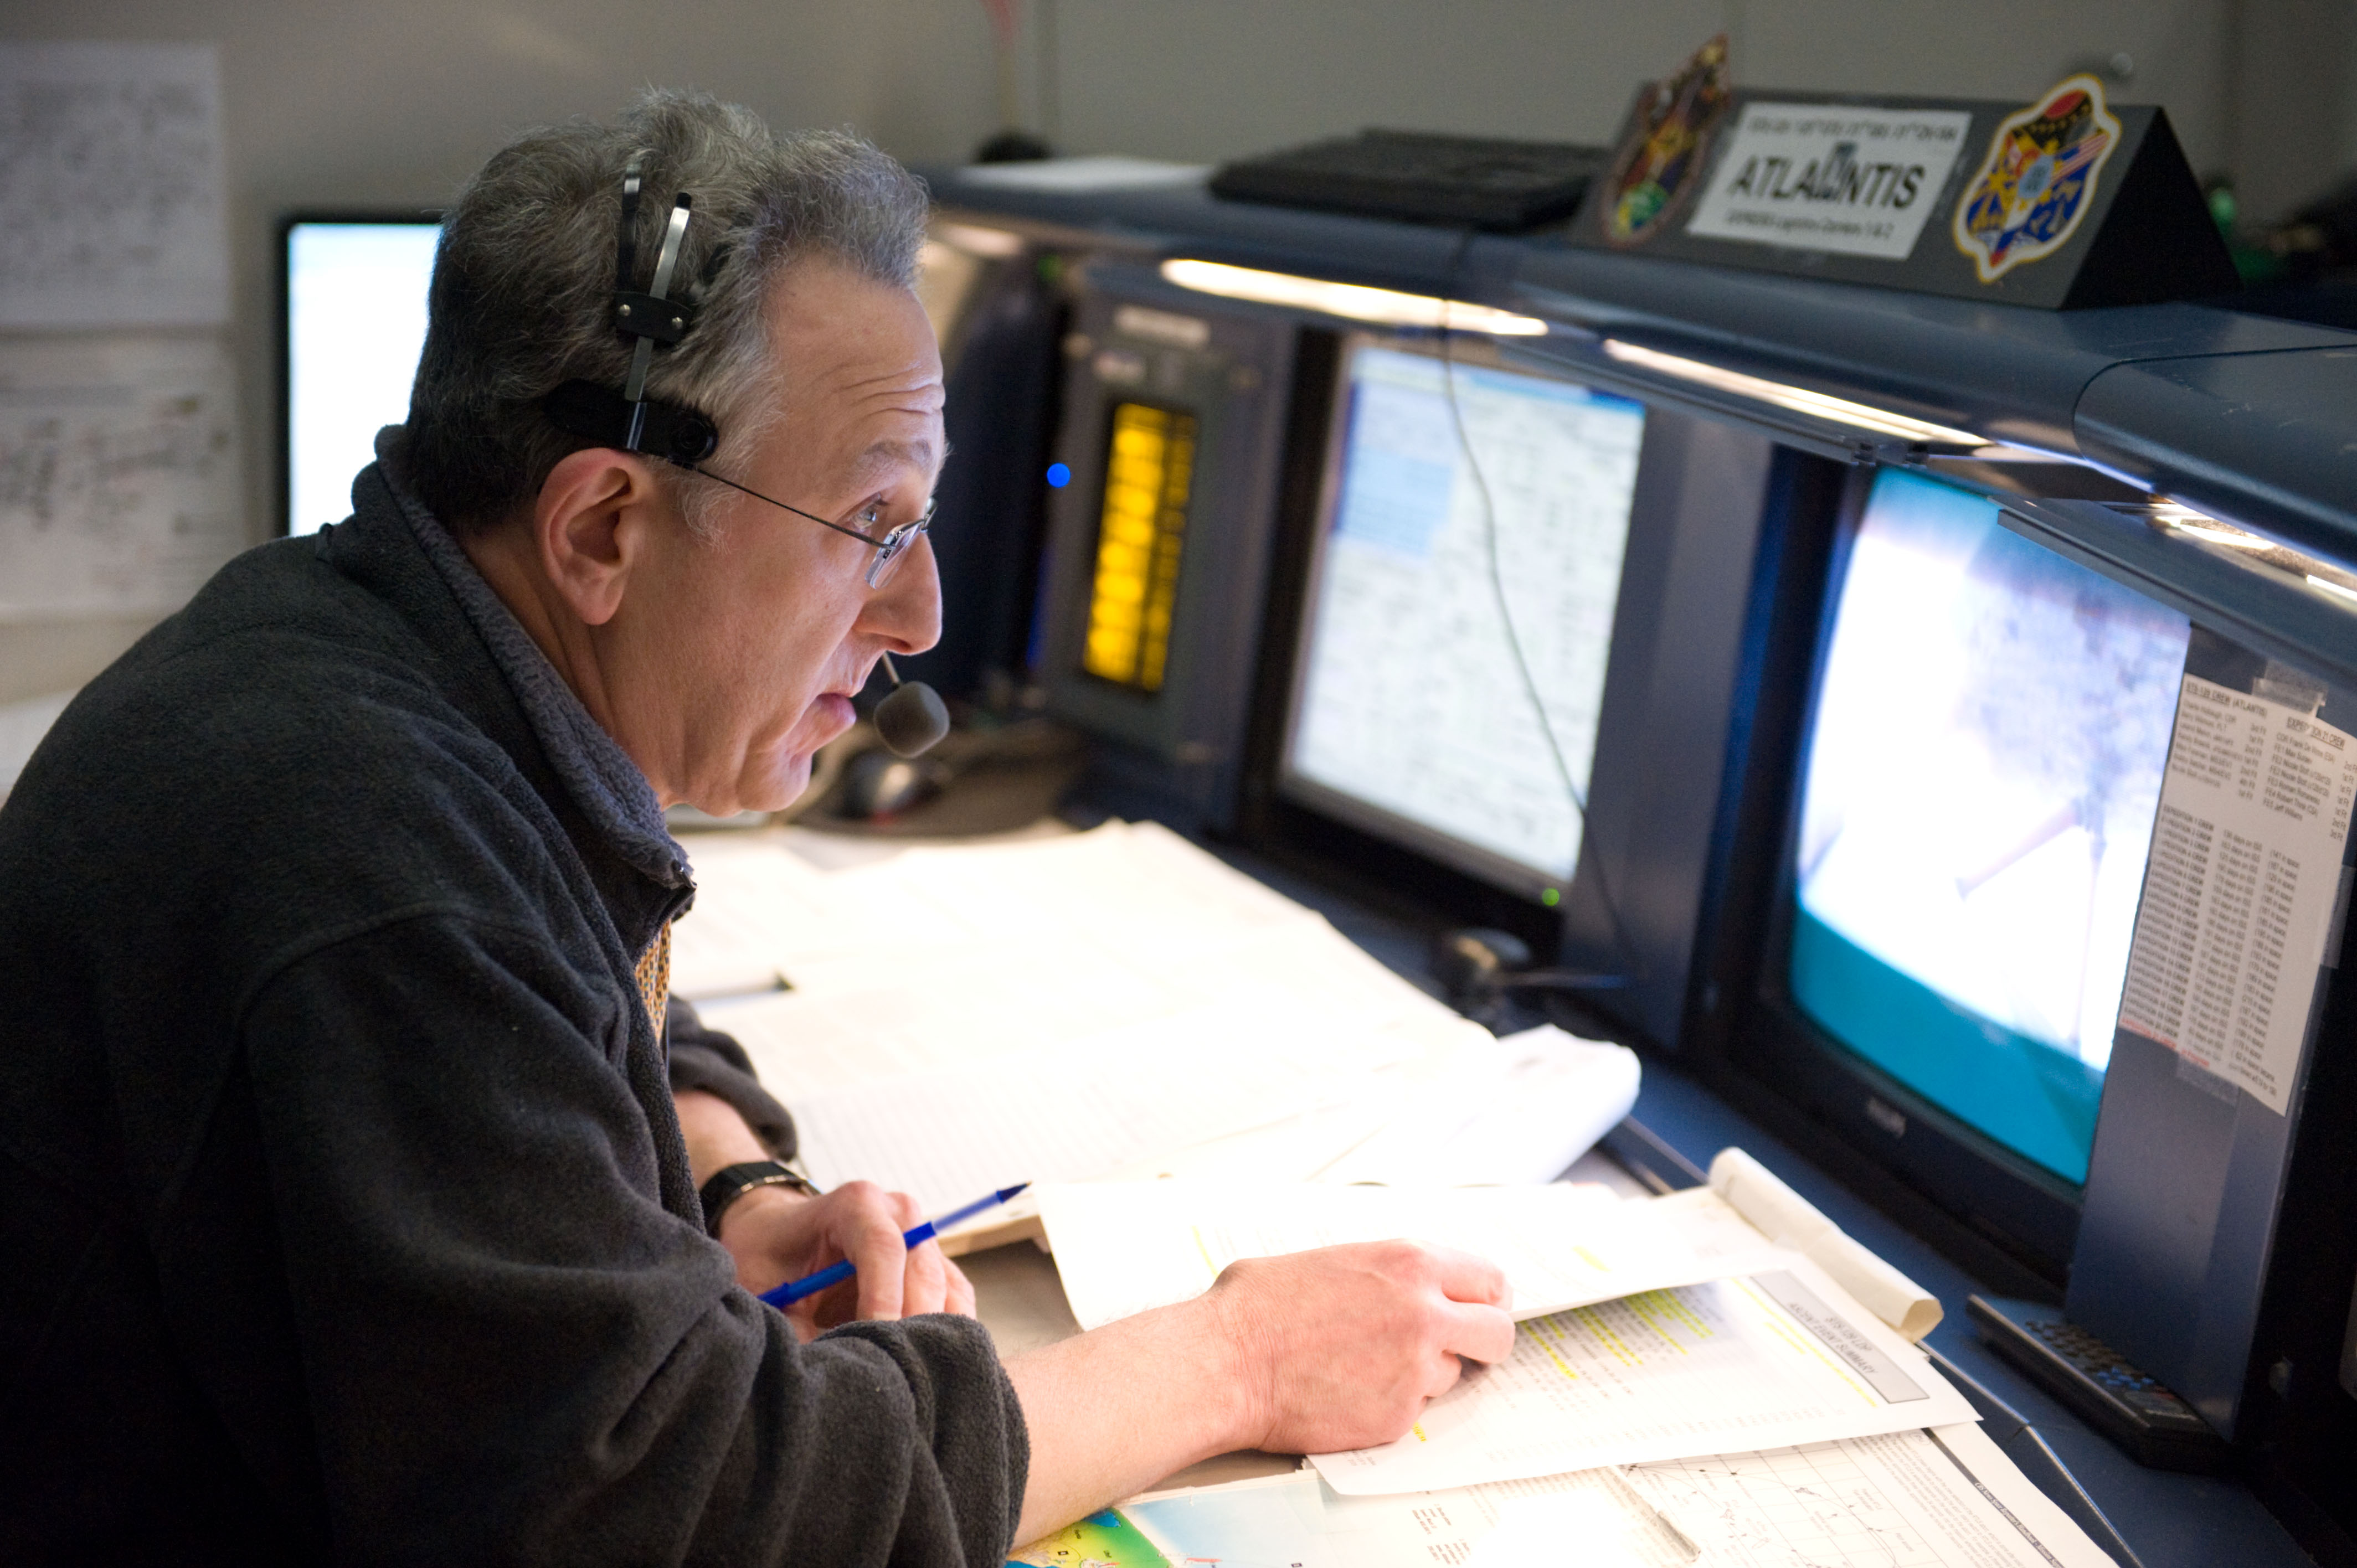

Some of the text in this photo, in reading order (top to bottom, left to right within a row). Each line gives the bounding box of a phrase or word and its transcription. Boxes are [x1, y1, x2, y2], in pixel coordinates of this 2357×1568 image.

[1728, 153, 1926, 210] ATLANTIS
[2286, 715, 2322, 739] EXPEDION
[2329, 734, 2345, 749] CREW
